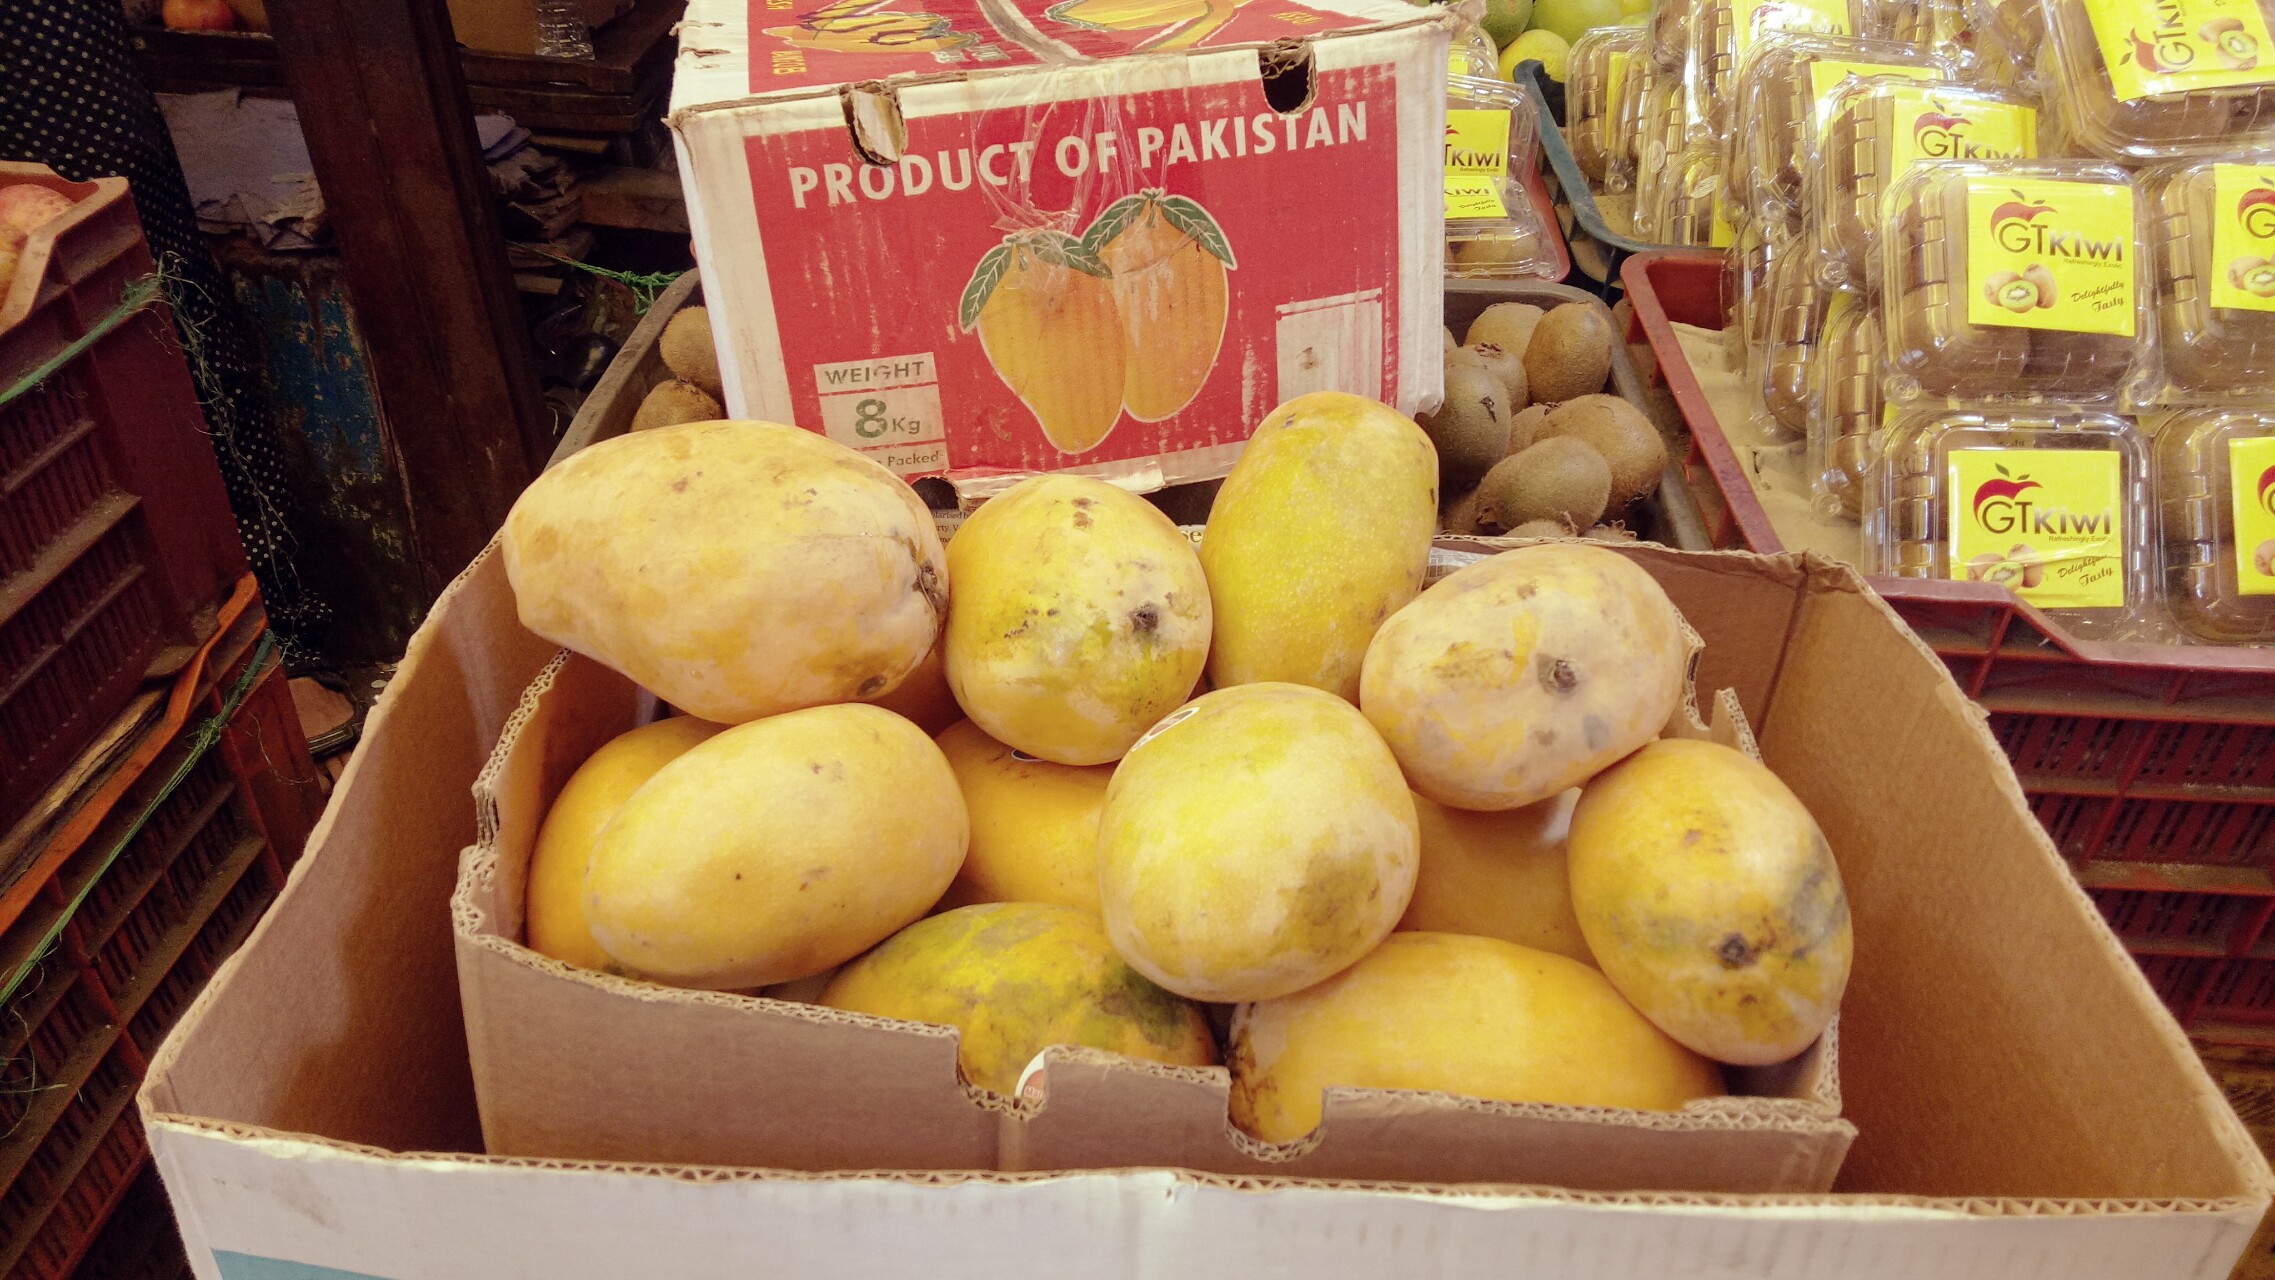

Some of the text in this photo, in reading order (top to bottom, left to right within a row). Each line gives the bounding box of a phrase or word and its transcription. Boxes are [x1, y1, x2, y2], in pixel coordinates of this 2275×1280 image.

[788, 101, 1367, 208] PRODUCT OF PAKISTAN
[2071, 281, 2124, 302] Delightfully
[2092, 297, 2124, 312] Tasty
[825, 361, 925, 384] WEIGHT
[888, 451, 939, 467] Packed
[2079, 567, 2113, 586] Tasty
